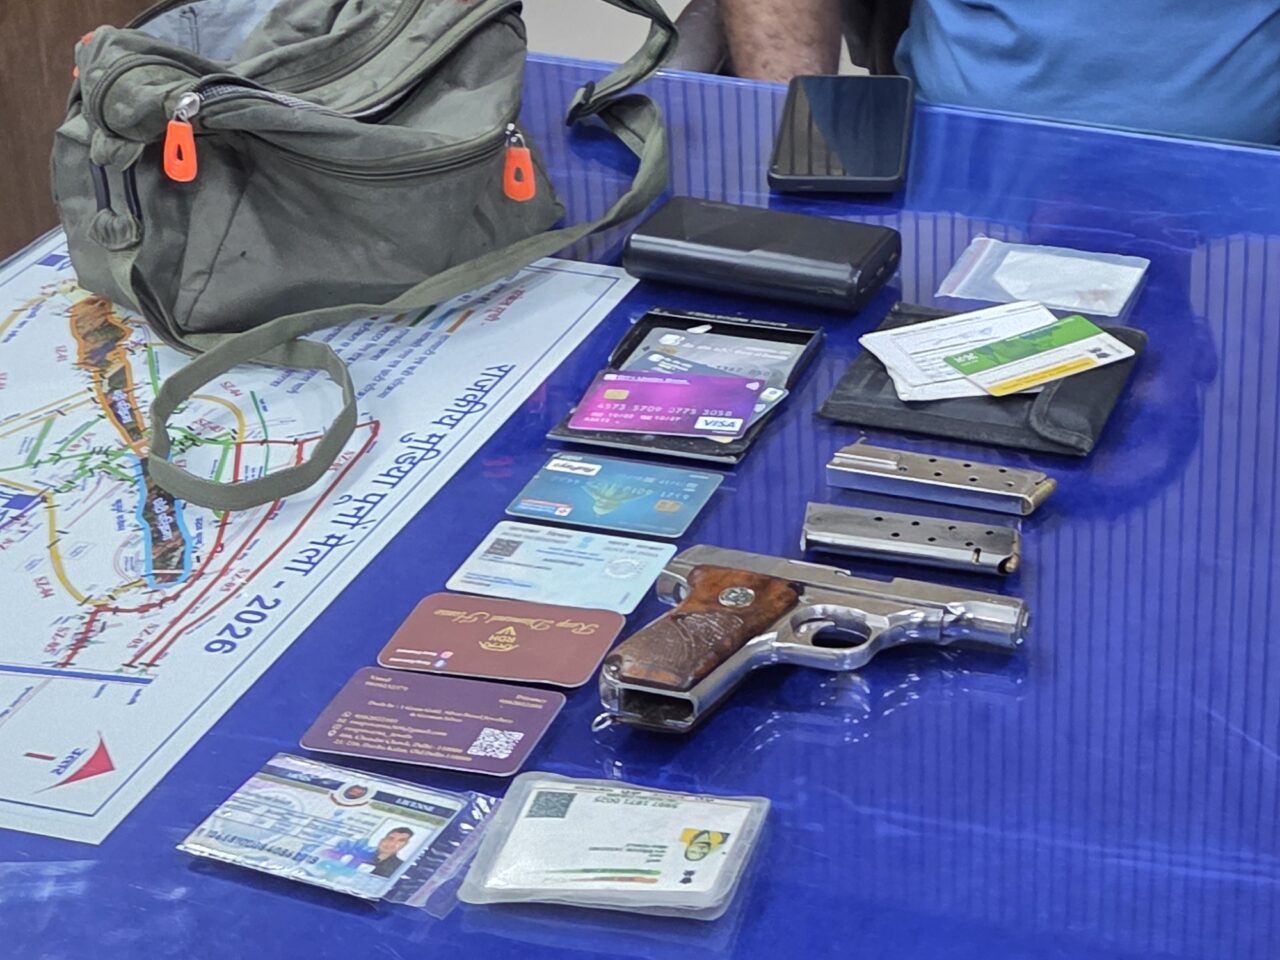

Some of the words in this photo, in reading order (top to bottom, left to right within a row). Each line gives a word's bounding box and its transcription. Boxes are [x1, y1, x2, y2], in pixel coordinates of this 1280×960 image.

[431, 364, 516, 429] राजकीय
[702, 418, 737, 430] VISA
[331, 492, 388, 530] पूनों
[283, 533, 355, 576] मेला
[204, 594, 281, 654] 2026
[50, 747, 88, 776] उत्तर
